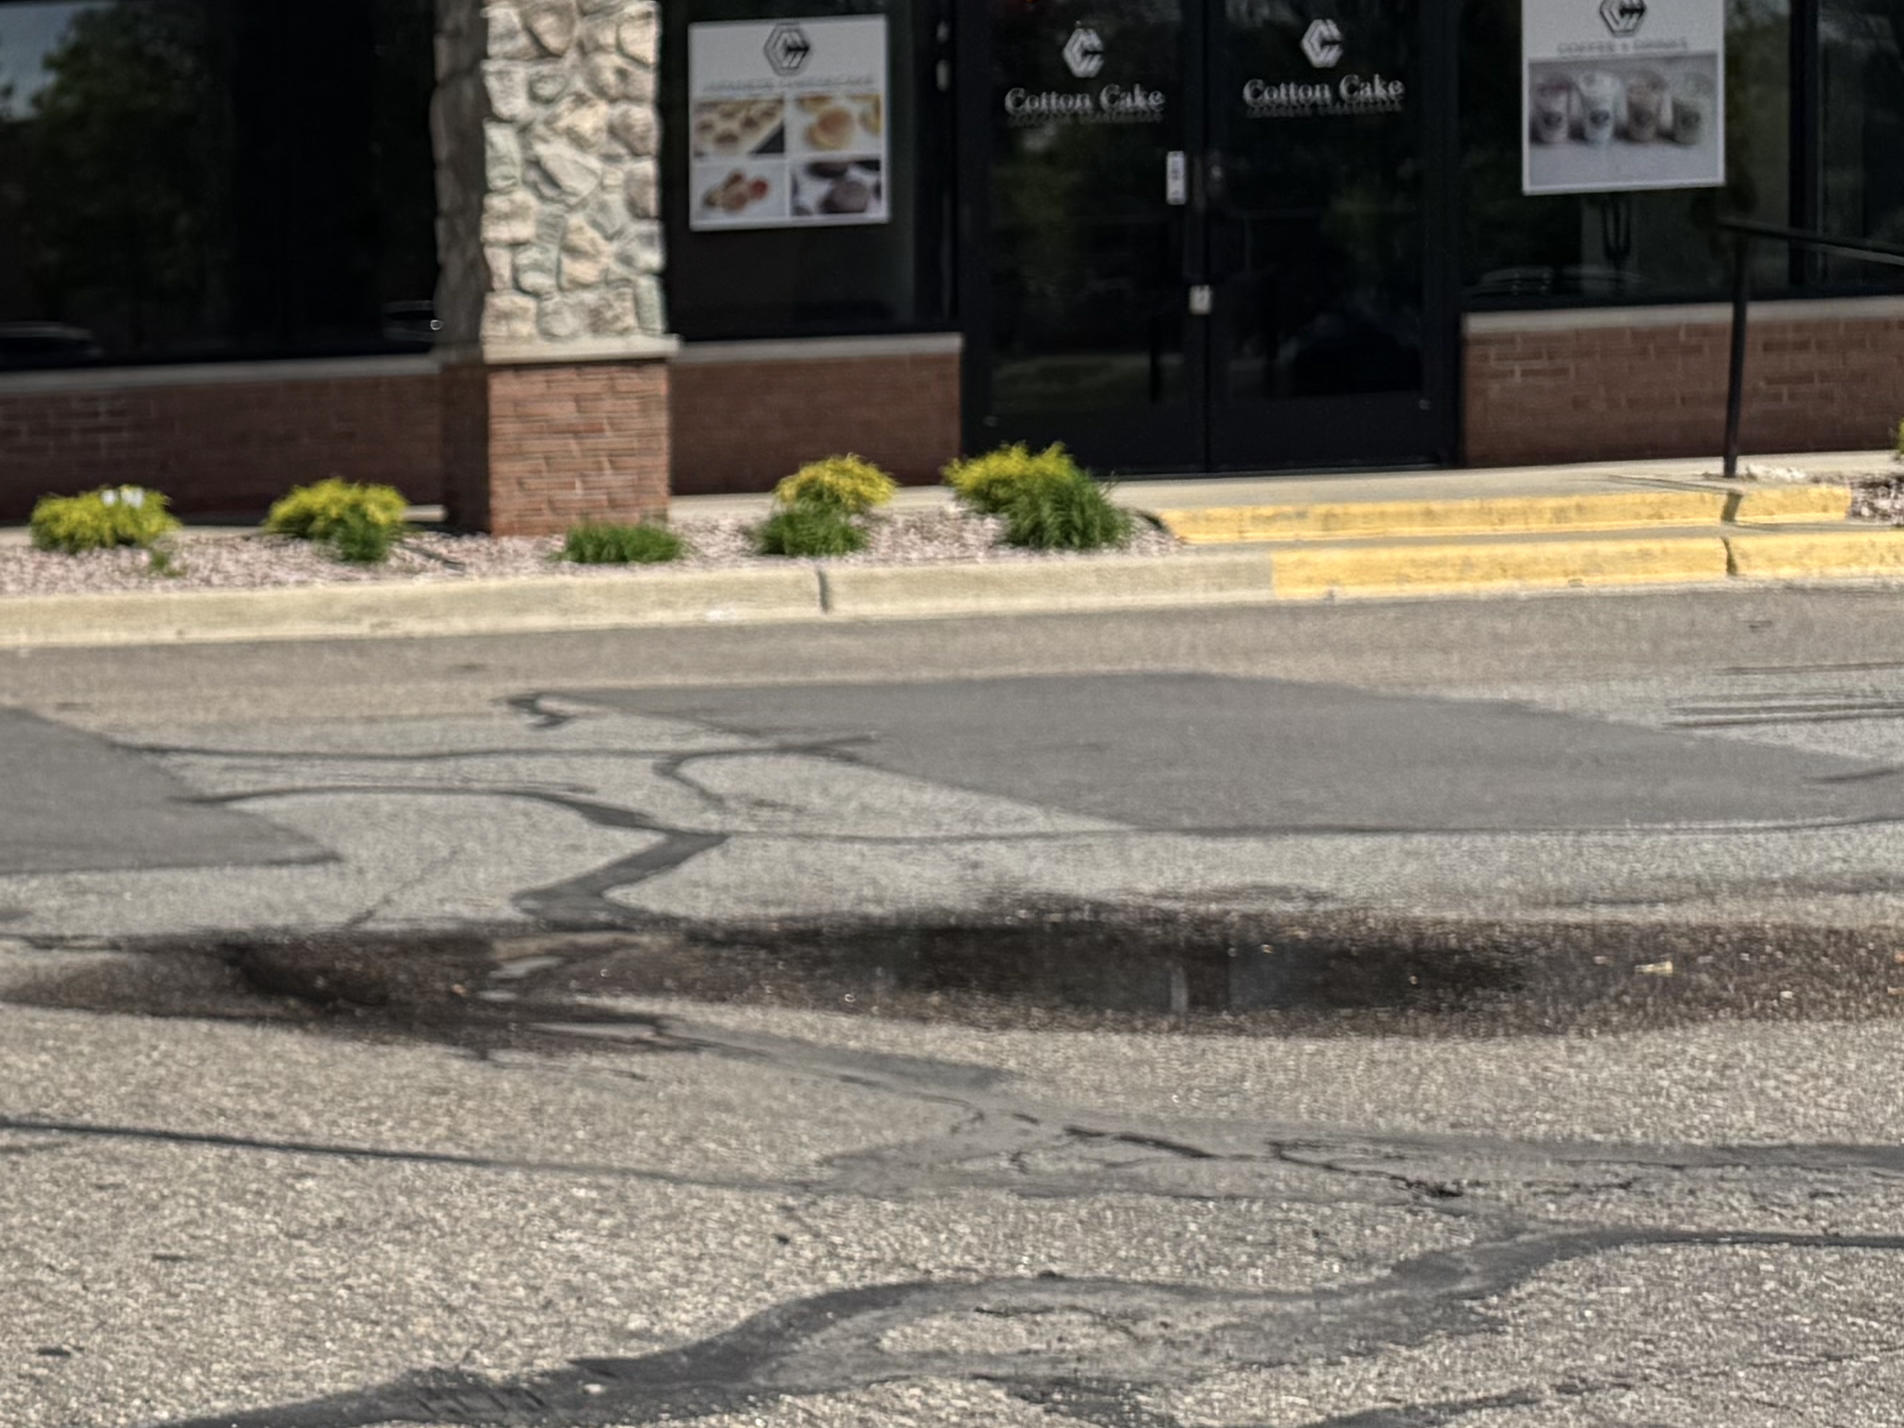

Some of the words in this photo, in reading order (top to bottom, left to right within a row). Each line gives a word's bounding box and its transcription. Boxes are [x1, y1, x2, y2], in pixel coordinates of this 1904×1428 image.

[1004, 87, 1092, 115] Cotton
[1100, 83, 1167, 113] Cake
[1243, 78, 1332, 107] Cotton
[1339, 73, 1406, 103] Cake
